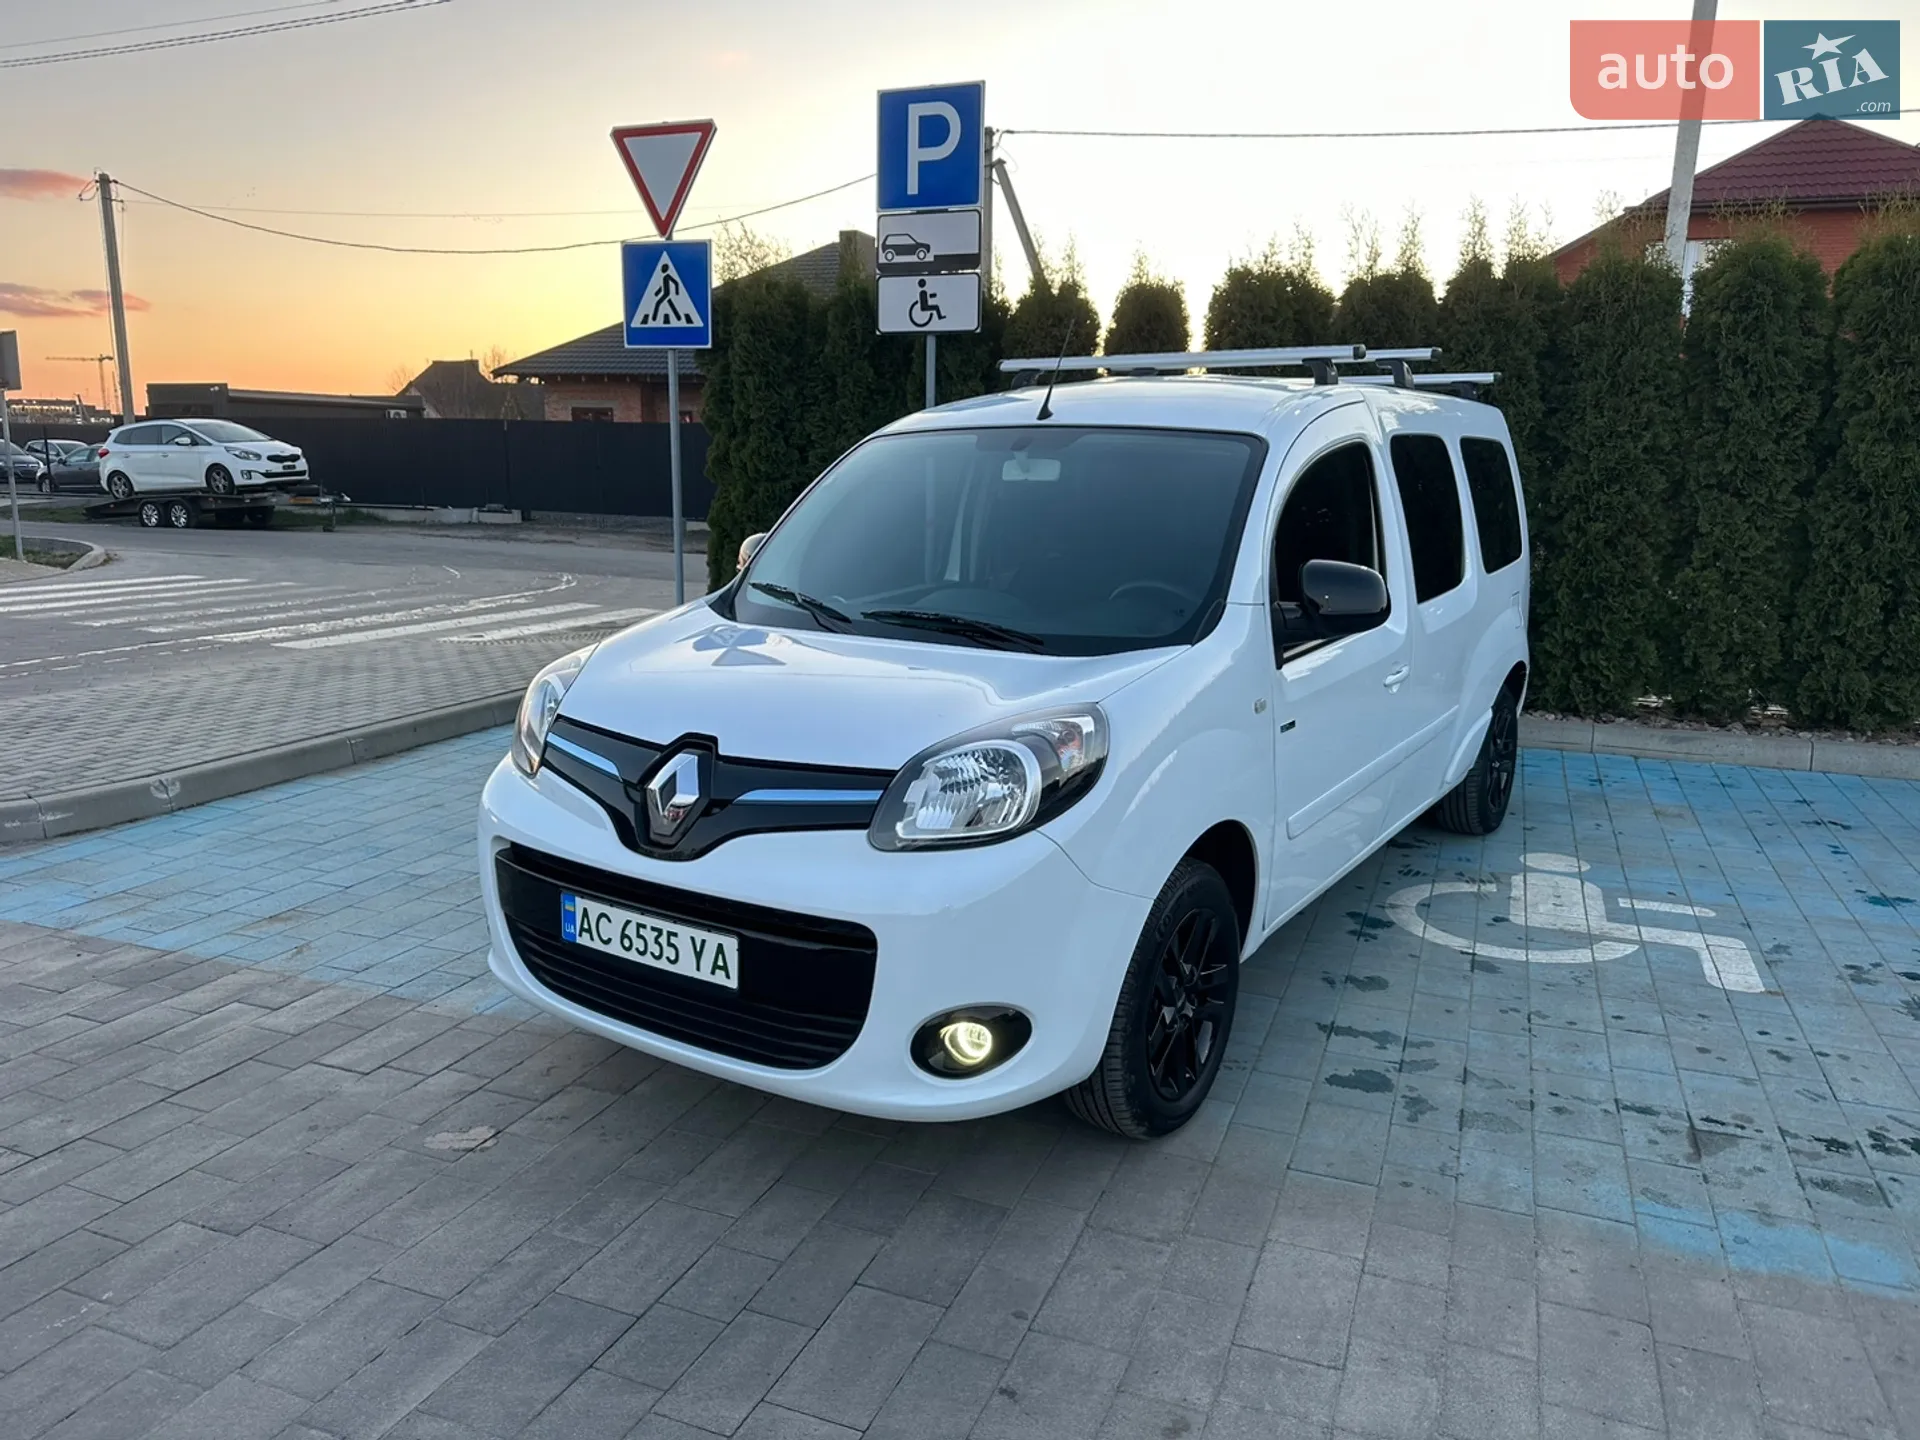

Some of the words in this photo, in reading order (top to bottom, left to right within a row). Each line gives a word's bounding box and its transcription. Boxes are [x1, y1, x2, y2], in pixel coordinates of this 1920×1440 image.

[907, 101, 962, 195] P
[578, 907, 613, 945] AC
[620, 919, 680, 965] 6535
[690, 936, 731, 980] YA
